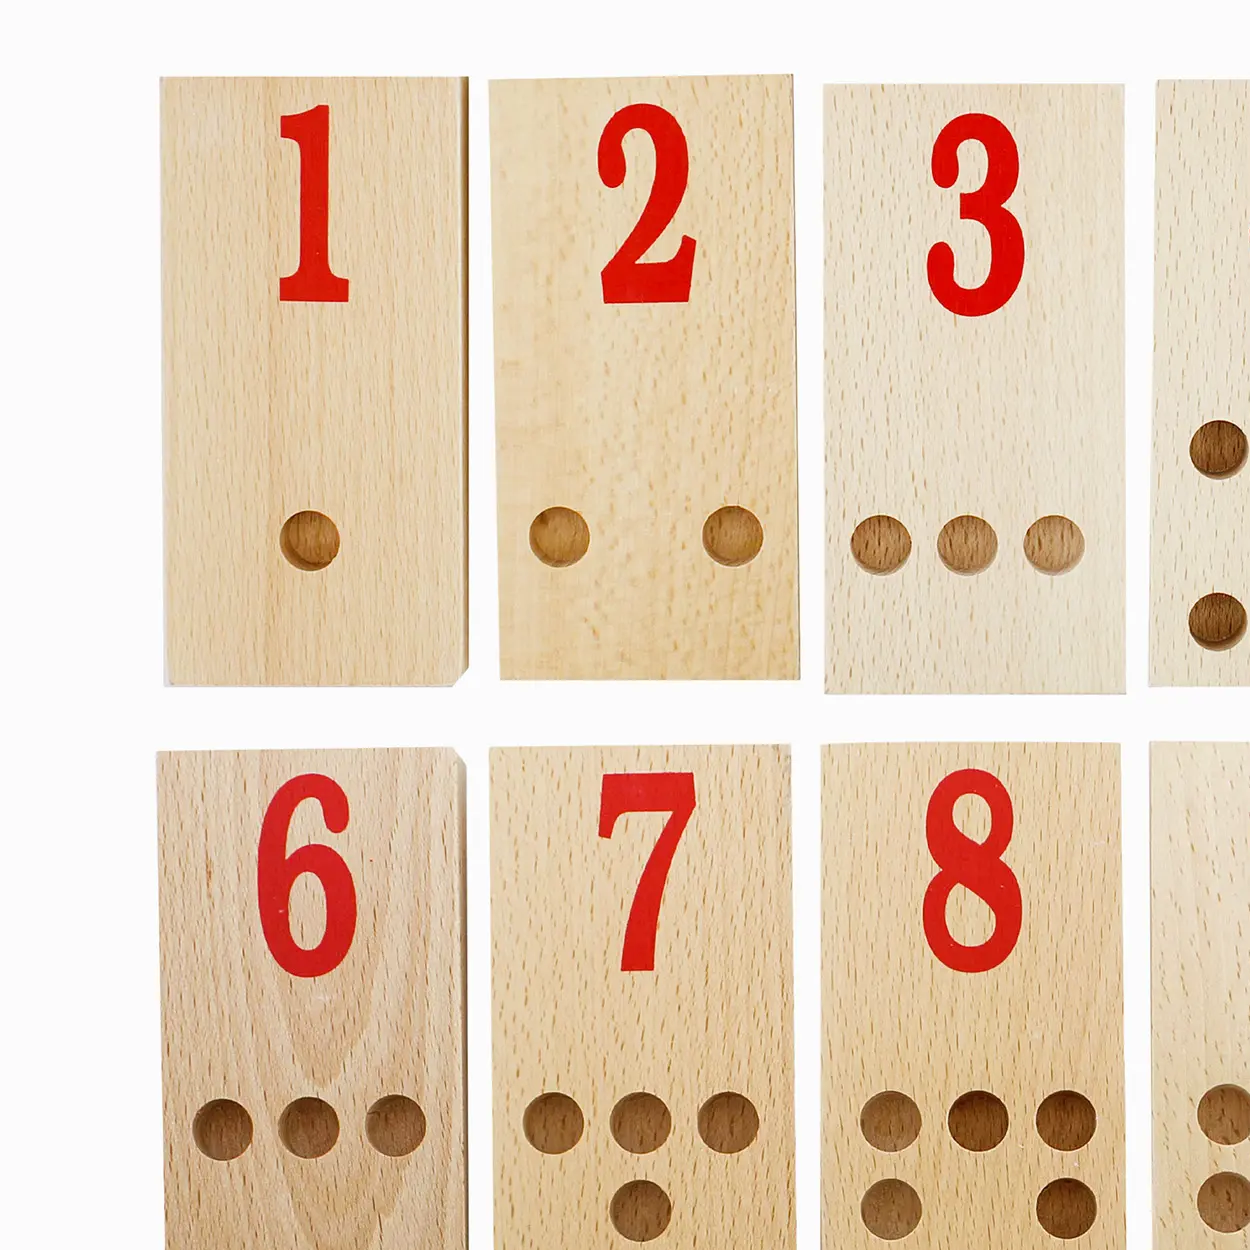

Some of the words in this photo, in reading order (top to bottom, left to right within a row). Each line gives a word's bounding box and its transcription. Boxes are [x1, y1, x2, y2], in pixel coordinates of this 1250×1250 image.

[280, 105, 349, 302] 1
[598, 104, 696, 304] 2
[927, 113, 1024, 316] 3
[258, 774, 356, 978] 6
[599, 773, 696, 971] 7
[923, 769, 1022, 973] 8
